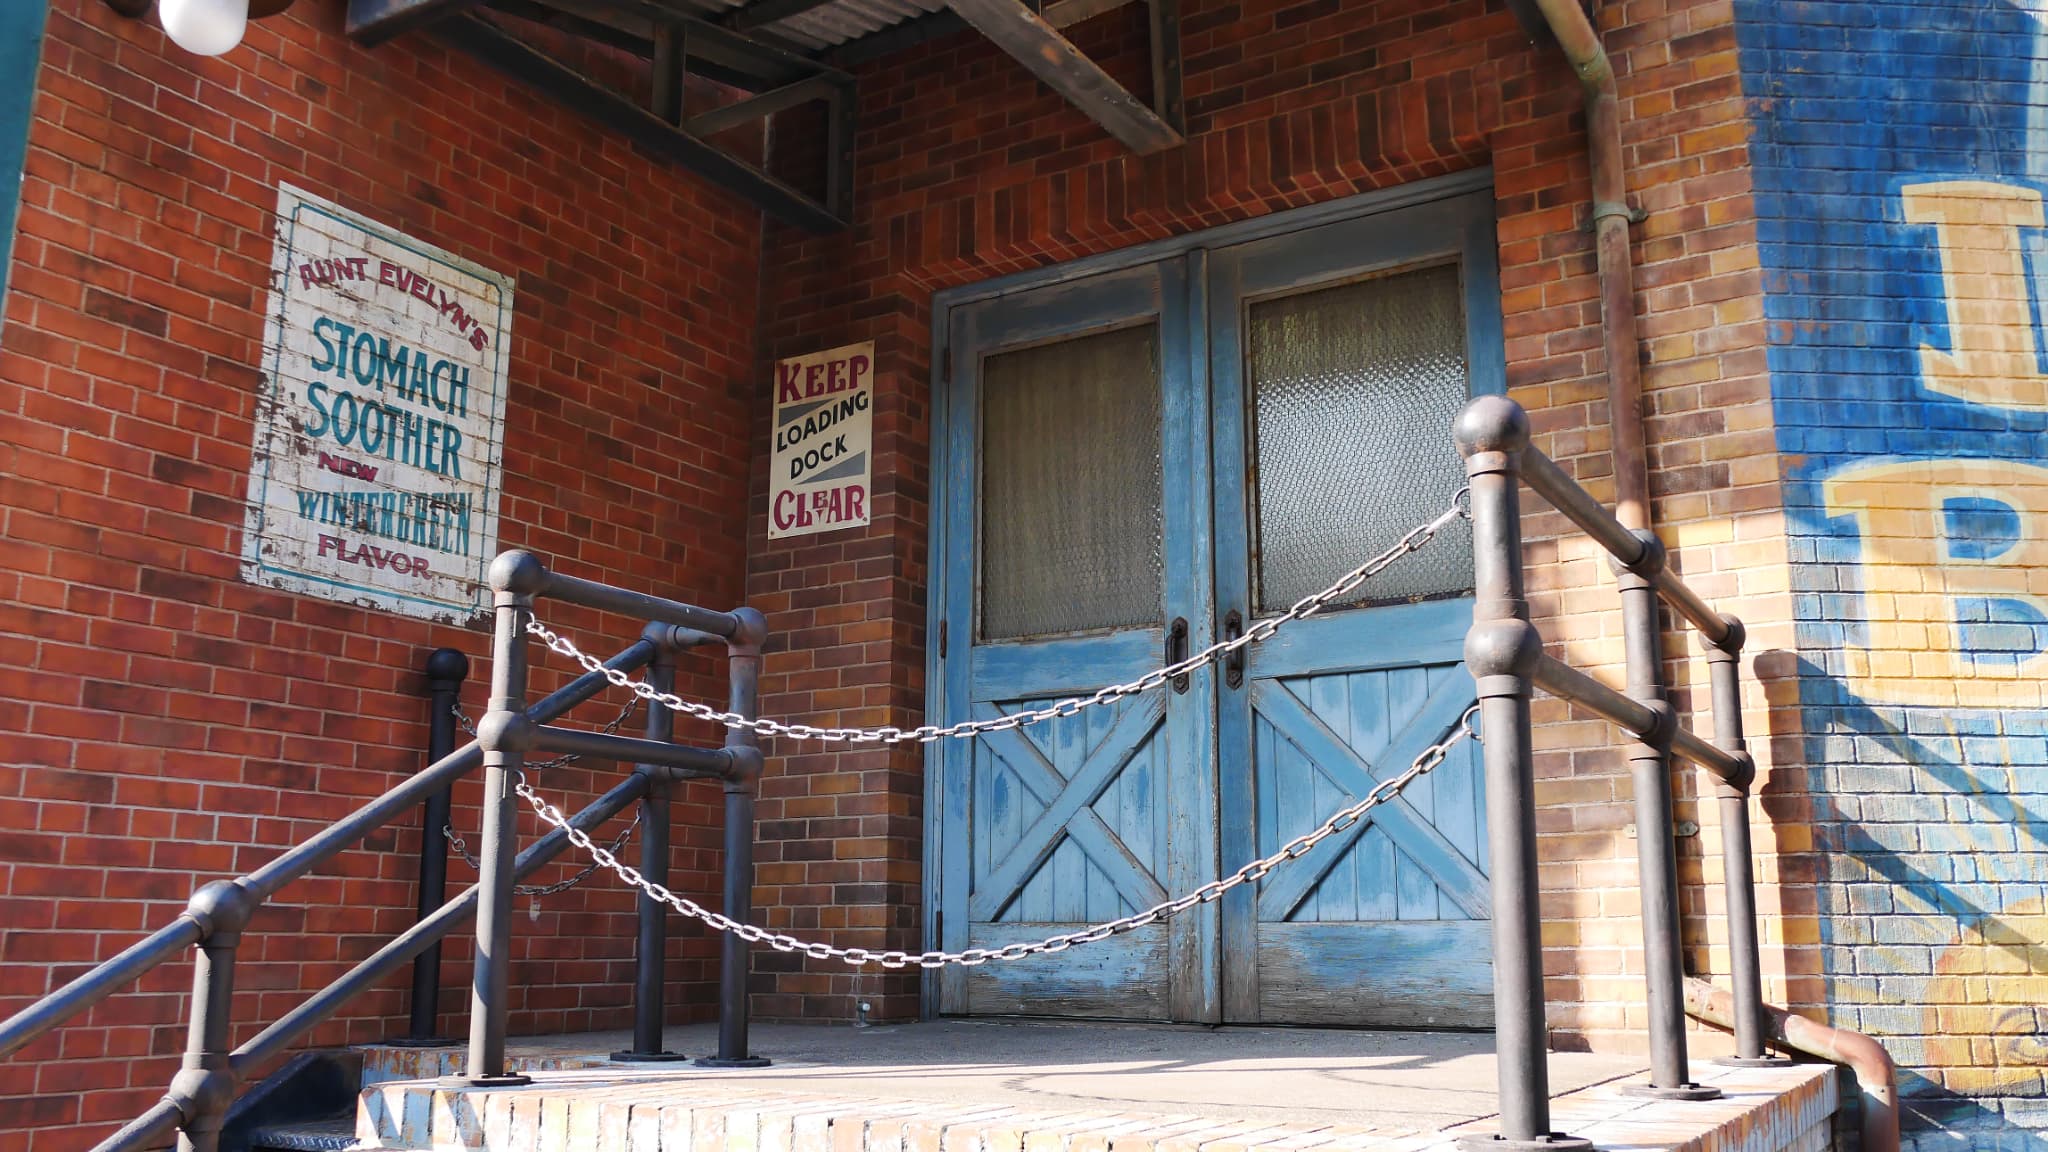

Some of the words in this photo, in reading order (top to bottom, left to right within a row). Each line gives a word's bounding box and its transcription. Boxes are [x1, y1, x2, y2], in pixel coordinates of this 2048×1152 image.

[299, 257, 368, 290] AUNT
[380, 261, 489, 351] EVELYN'S
[311, 317, 470, 418] STOMACH
[778, 355, 869, 404] KEEP
[304, 382, 463, 480] SOOTHER
[777, 391, 868, 453] LOADING
[318, 452, 378, 482] NEW
[791, 434, 848, 480] DOCK
[297, 491, 472, 556] WINTERGREEN
[773, 485, 865, 531] CLEAR
[317, 533, 432, 580] FLAVOR
